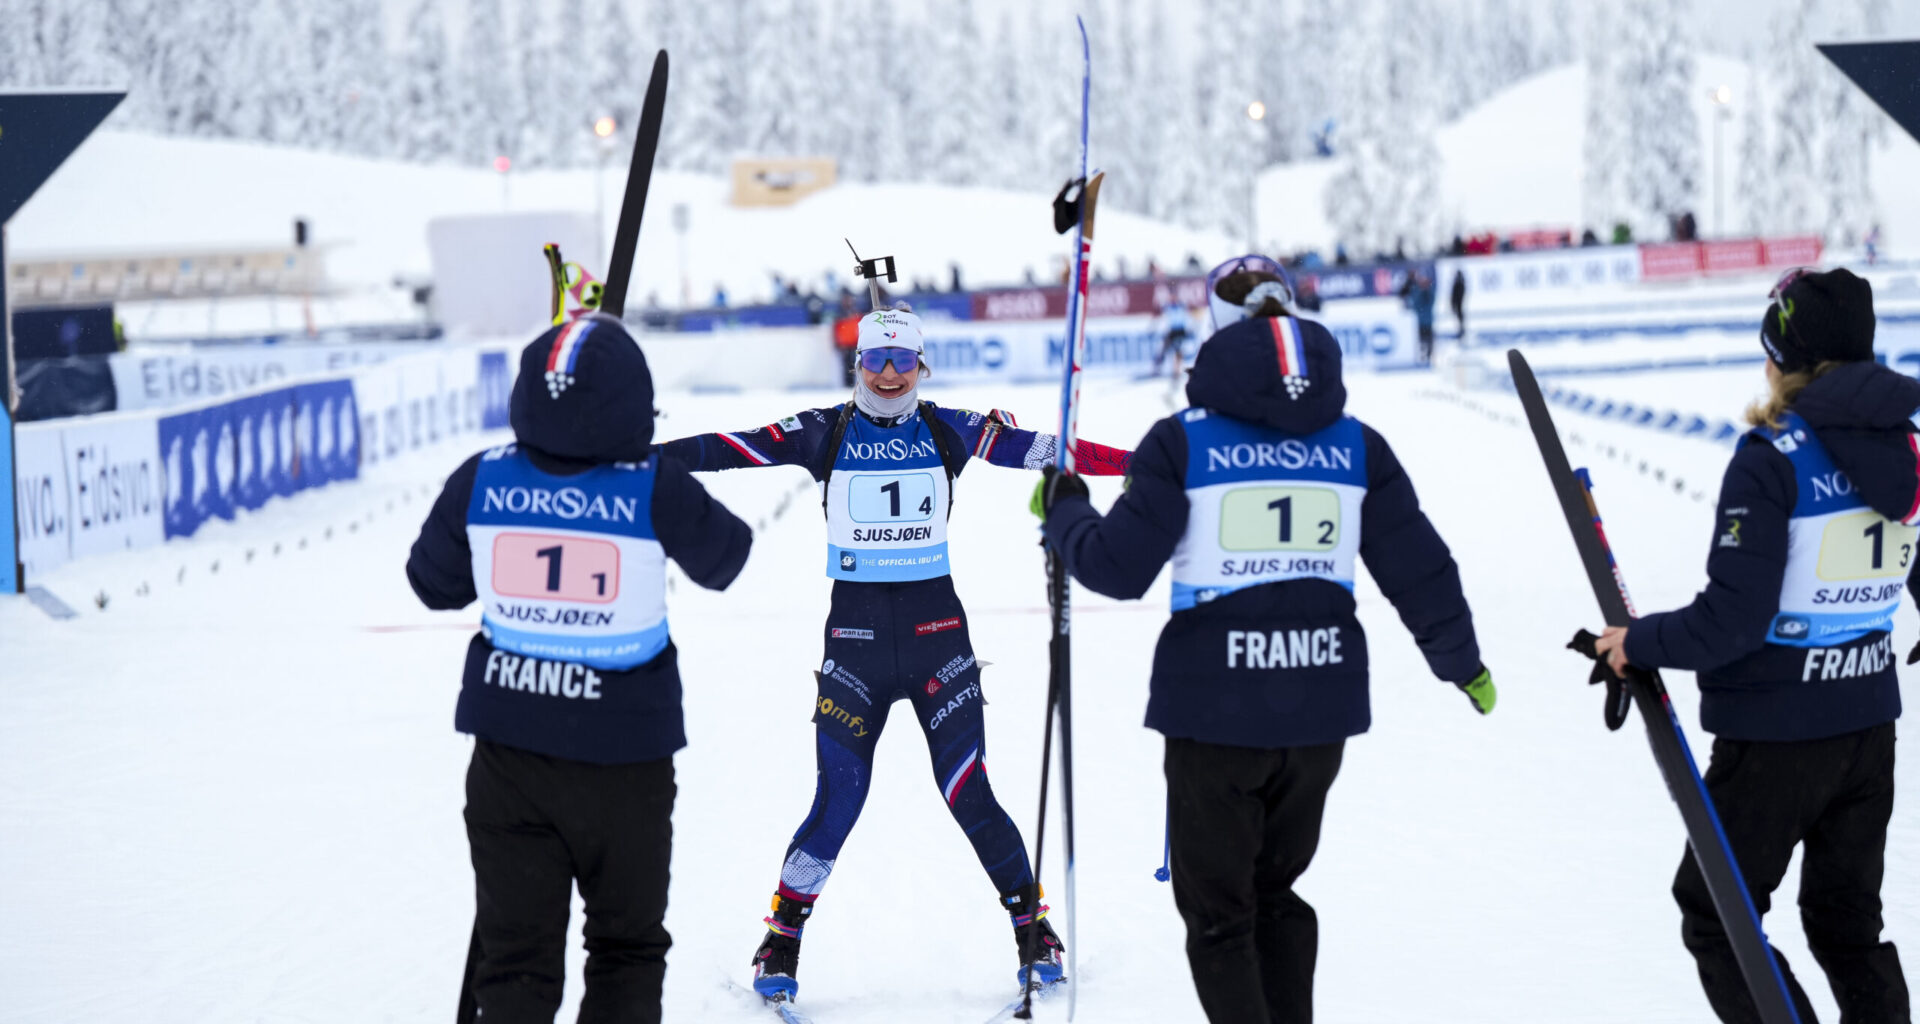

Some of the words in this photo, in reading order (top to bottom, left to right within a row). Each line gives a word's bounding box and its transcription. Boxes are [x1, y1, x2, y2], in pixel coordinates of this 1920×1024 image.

[844, 438, 936, 461] NORSAN
[1207, 440, 1351, 471] NORSAN
[483, 487, 637, 523] NORSAN
[880, 480, 900, 517] 1
[918, 496, 932, 515] 4
[853, 526, 932, 542] SJUSJØEN
[1267, 496, 1292, 543] 1
[1317, 520, 1335, 545] 2
[861, 558, 876, 567] THE
[878, 558, 917, 567] OFFICIAL
[919, 556, 932, 565] IBU
[1863, 519, 1884, 569] 1
[1899, 543, 1911, 567] 3
[536, 545, 564, 592] 1
[591, 572, 606, 596] 1
[1220, 559, 1335, 576] SJUSJØEN
[936, 654, 964, 678] CAISSE
[1227, 626, 1343, 669] FRANCE
[484, 651, 603, 699] FRANCE
[817, 696, 868, 738] somfy
[930, 687, 973, 730] CRAFT
